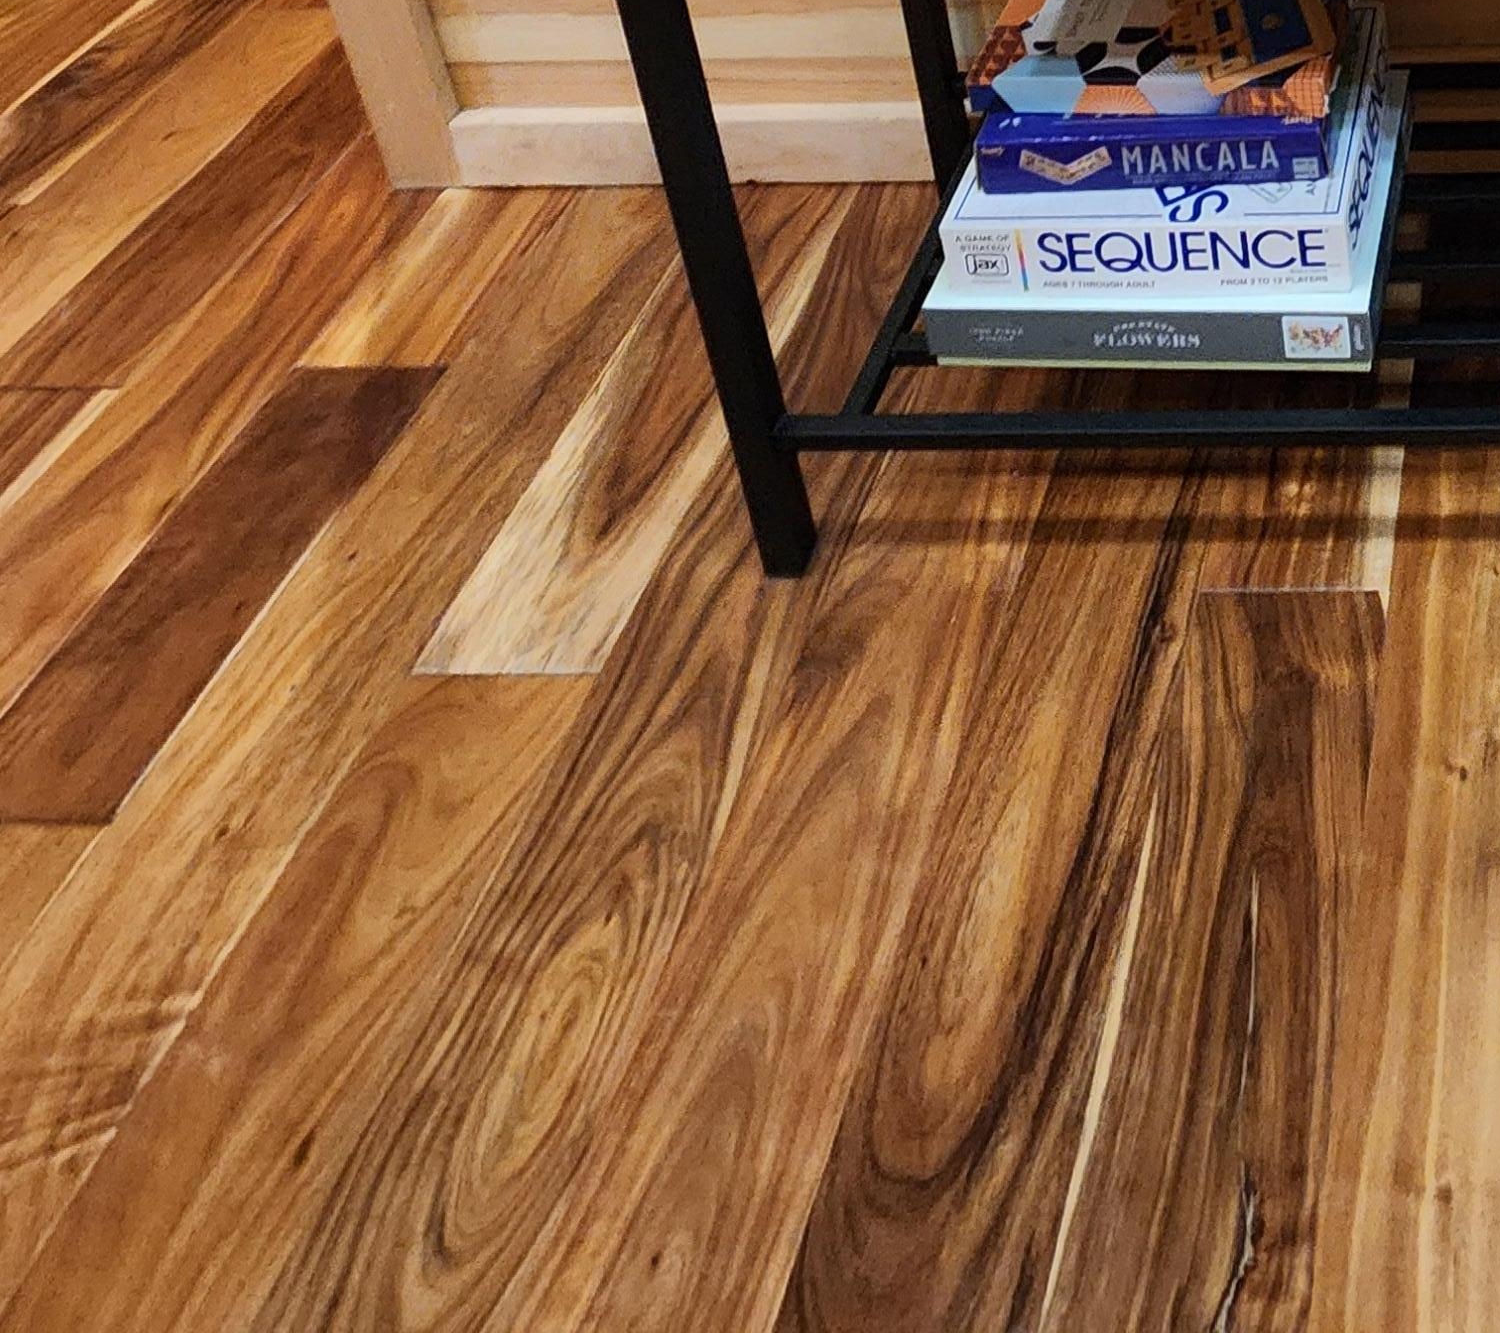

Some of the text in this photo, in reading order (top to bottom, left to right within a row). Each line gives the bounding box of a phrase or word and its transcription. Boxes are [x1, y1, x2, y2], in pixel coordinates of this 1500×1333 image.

[1120, 140, 1281, 176] MANCALA
[1036, 229, 1328, 274] SEQUENCE
[1220, 277, 1248, 287] FROM
